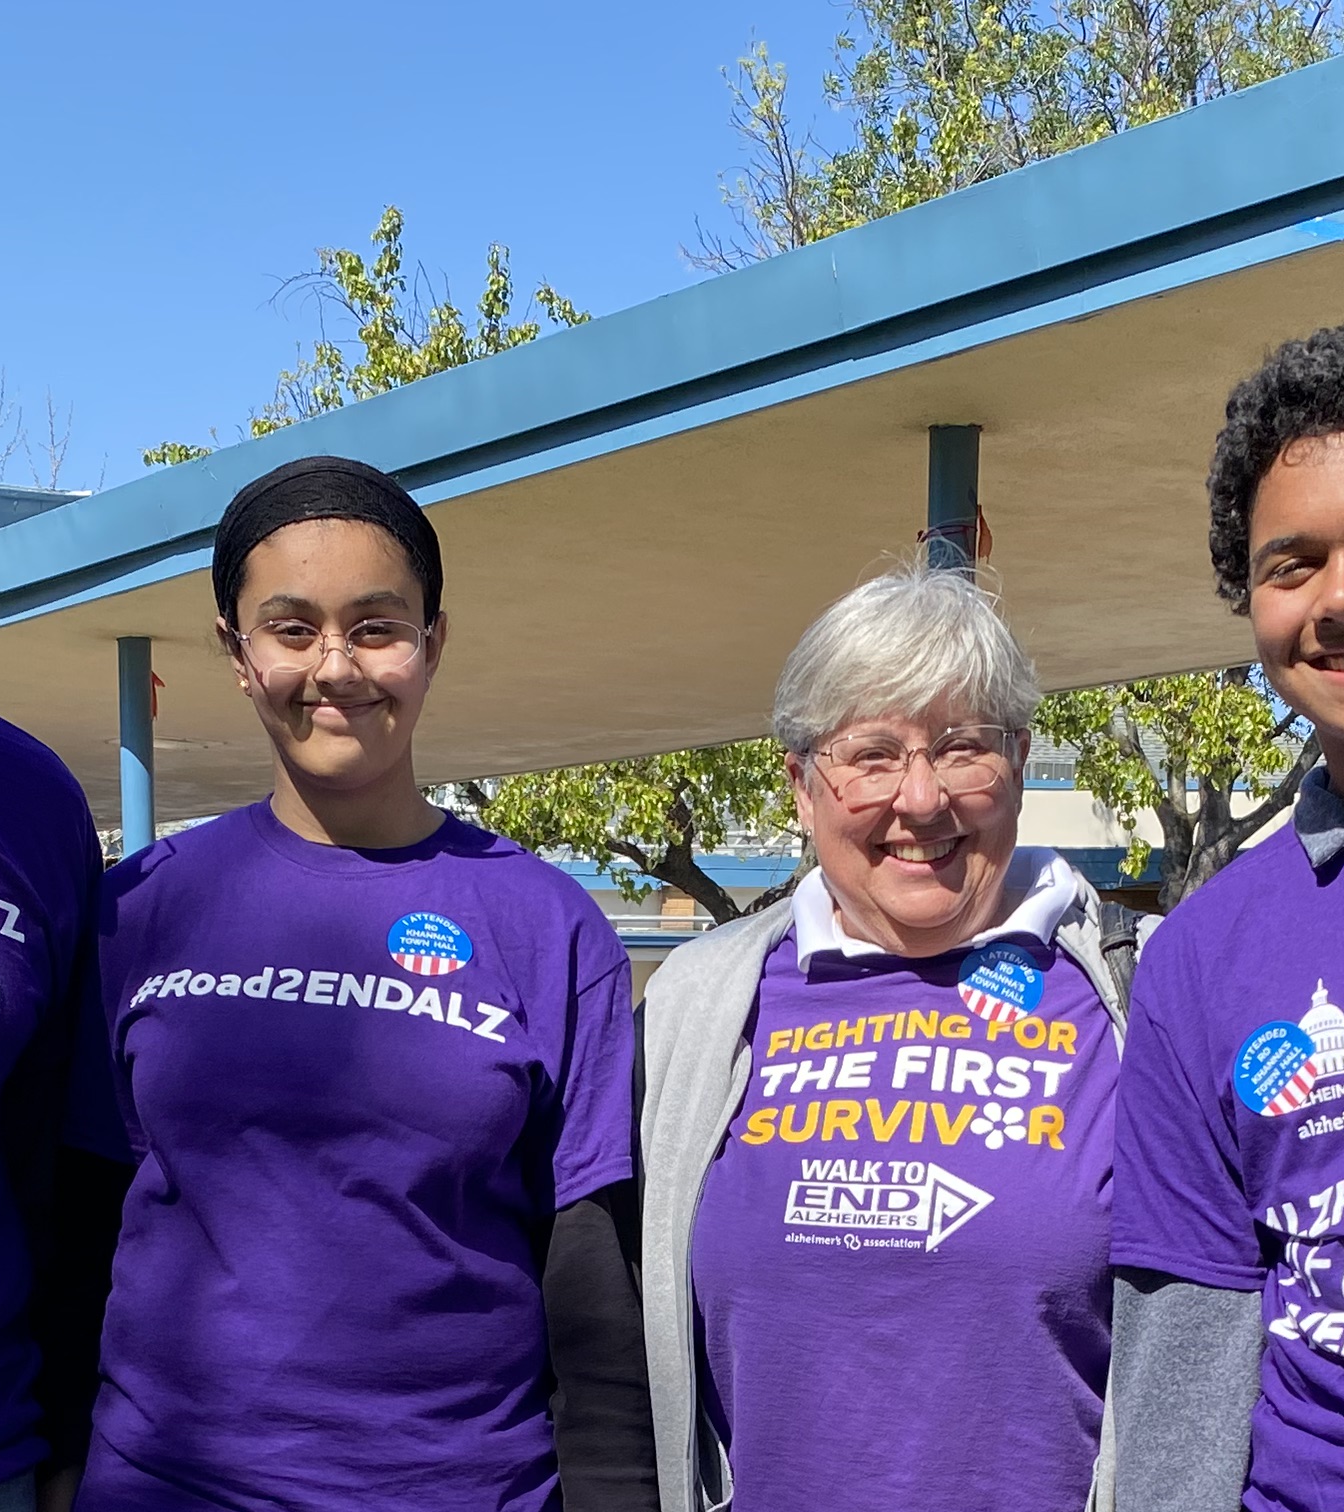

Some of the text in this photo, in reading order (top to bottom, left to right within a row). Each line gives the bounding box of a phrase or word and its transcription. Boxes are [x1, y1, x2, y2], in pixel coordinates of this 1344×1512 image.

[406, 929, 454, 943] KHANNA'S
[409, 913, 460, 936] ATTENDED
[424, 923, 439, 931] RO
[400, 936, 458, 951] TOWN HALL
[978, 966, 1026, 993] KHANNA'S
[988, 950, 1036, 984] ATTENDED
[999, 963, 1014, 975] RO
[971, 973, 1025, 1005] TOWN HALL
[130, 967, 512, 1043] #Road2ENDALZ
[766, 1010, 1078, 1058] FIGHTING FOR
[1242, 1028, 1288, 1070] ATTENDED
[1251, 1040, 1293, 1085] KHANNA'S
[1257, 1047, 1272, 1062] RO
[760, 1046, 1073, 1098] THE FIRST
[1253, 1046, 1303, 1097] TOWN HALL
[801, 1158, 924, 1184] WALK TO
[794, 1185, 922, 1212] END
[789, 1209, 919, 1227] ALZHEIMER'S
[785, 1233, 842, 1247] alzheimer's
